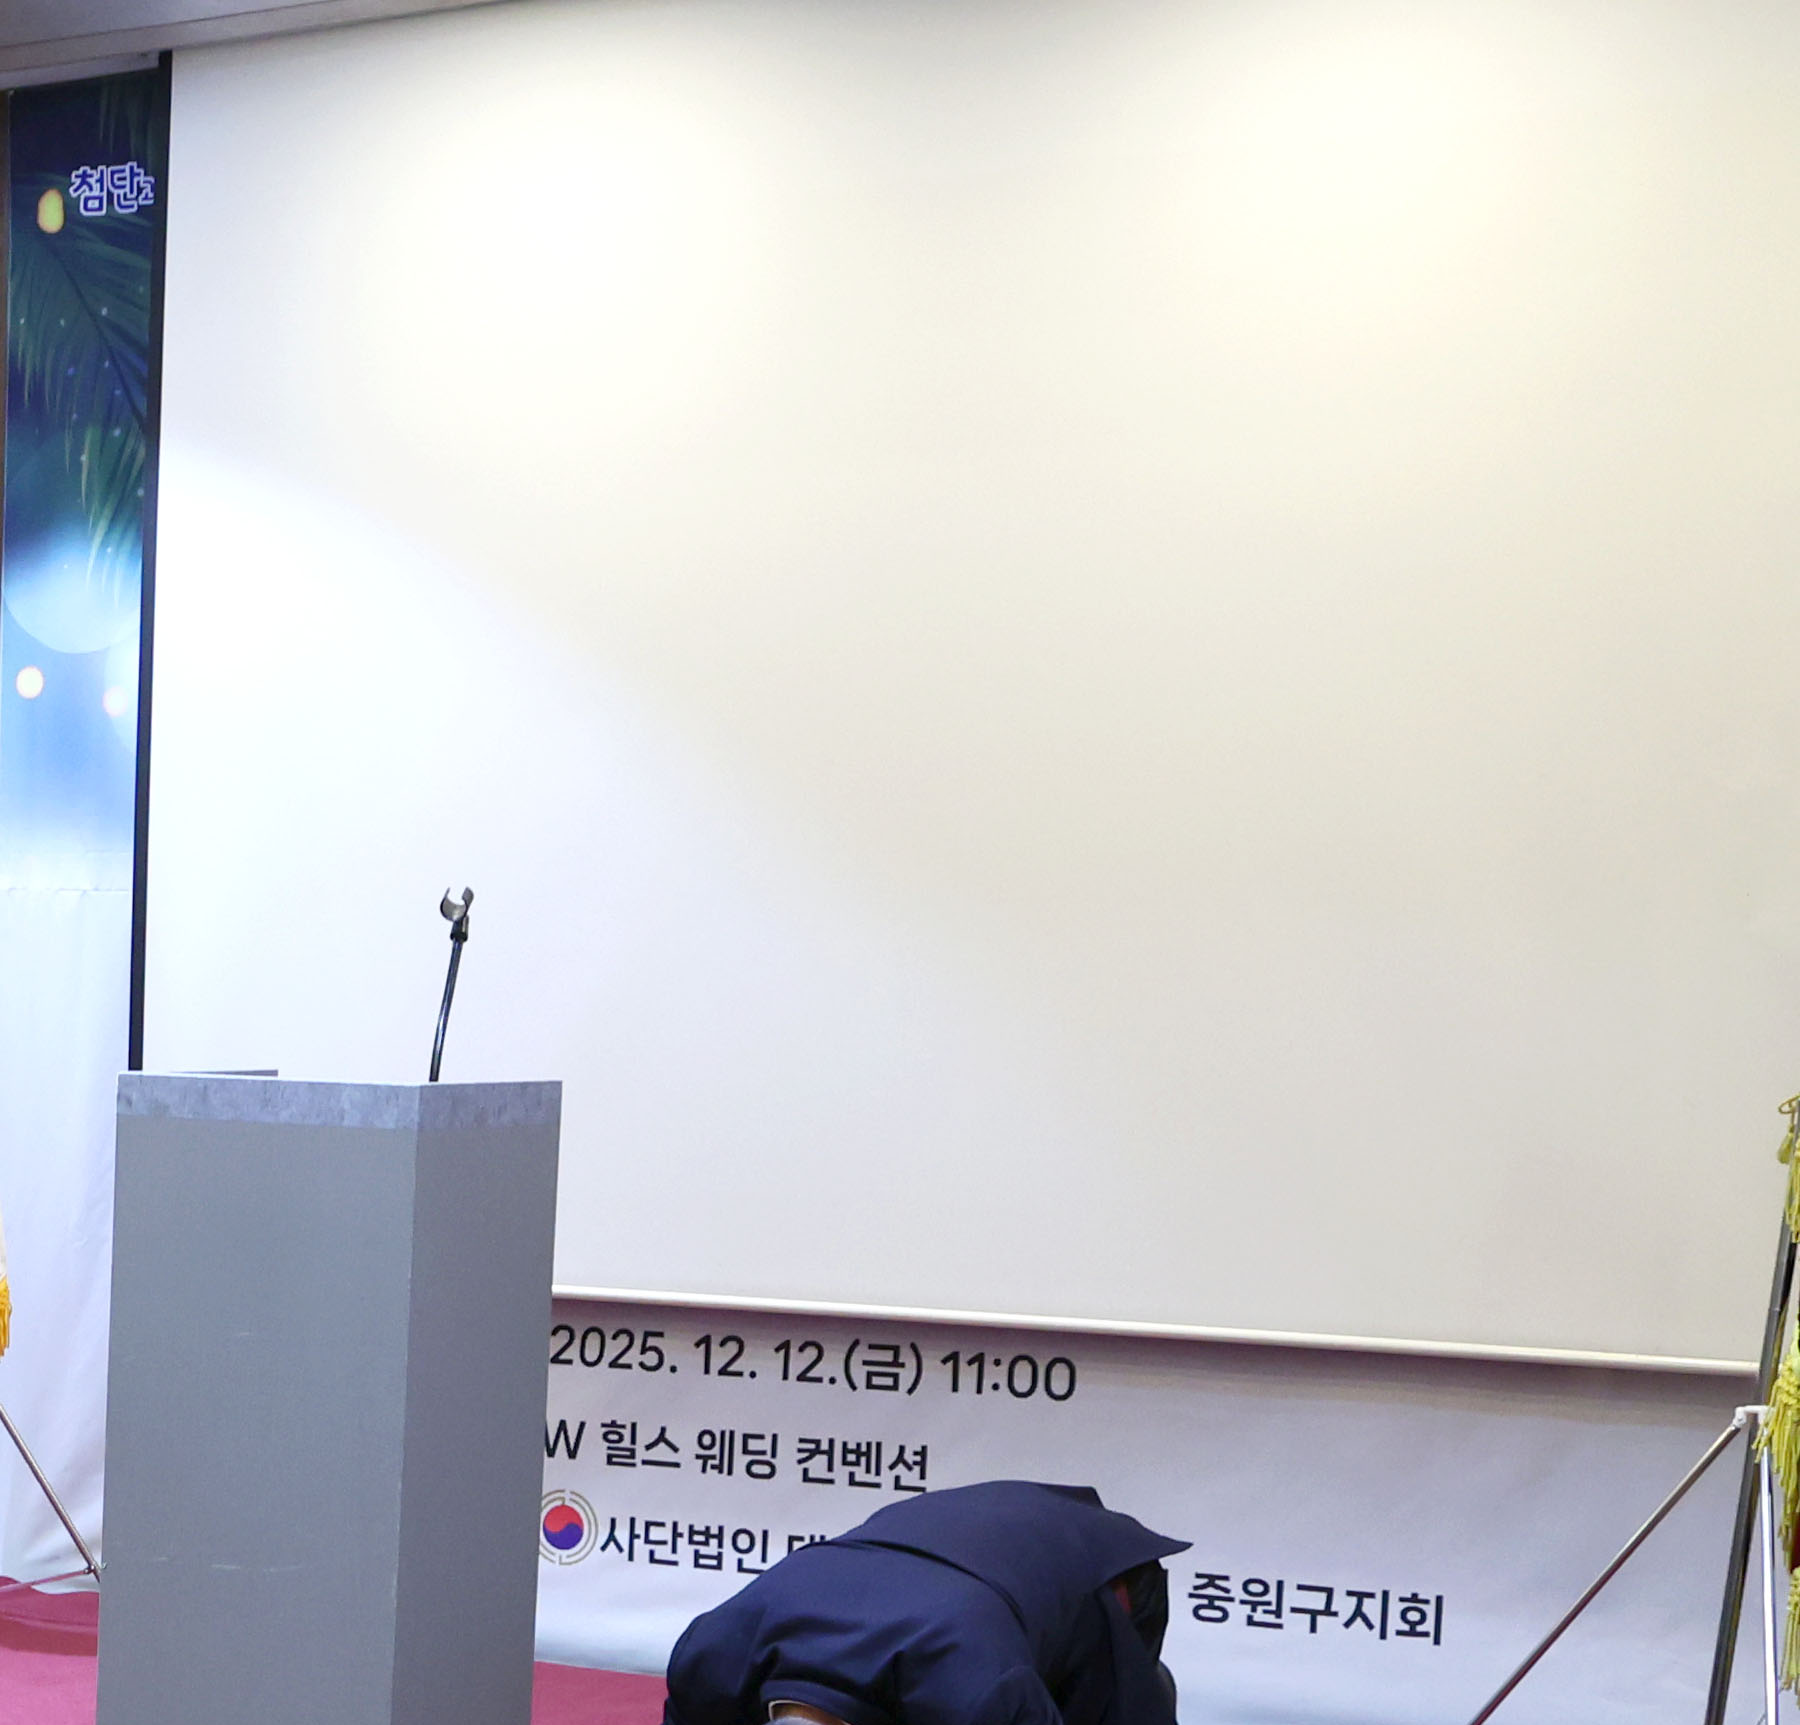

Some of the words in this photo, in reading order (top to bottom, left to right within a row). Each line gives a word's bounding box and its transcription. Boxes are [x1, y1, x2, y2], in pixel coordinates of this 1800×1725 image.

[550, 1325, 677, 1375] 2025.
[694, 1334, 757, 1380] 12.
[774, 1339, 924, 1396] 12.(금)
[940, 1350, 1078, 1401] 11:00
[544, 1419, 586, 1460] W
[600, 1419, 682, 1470] 힐스
[694, 1429, 780, 1480] 웨딩
[796, 1436, 929, 1494] 컨벤션
[600, 1516, 770, 1576] 사단법인
[1187, 1571, 1444, 1647] 중원구지회
